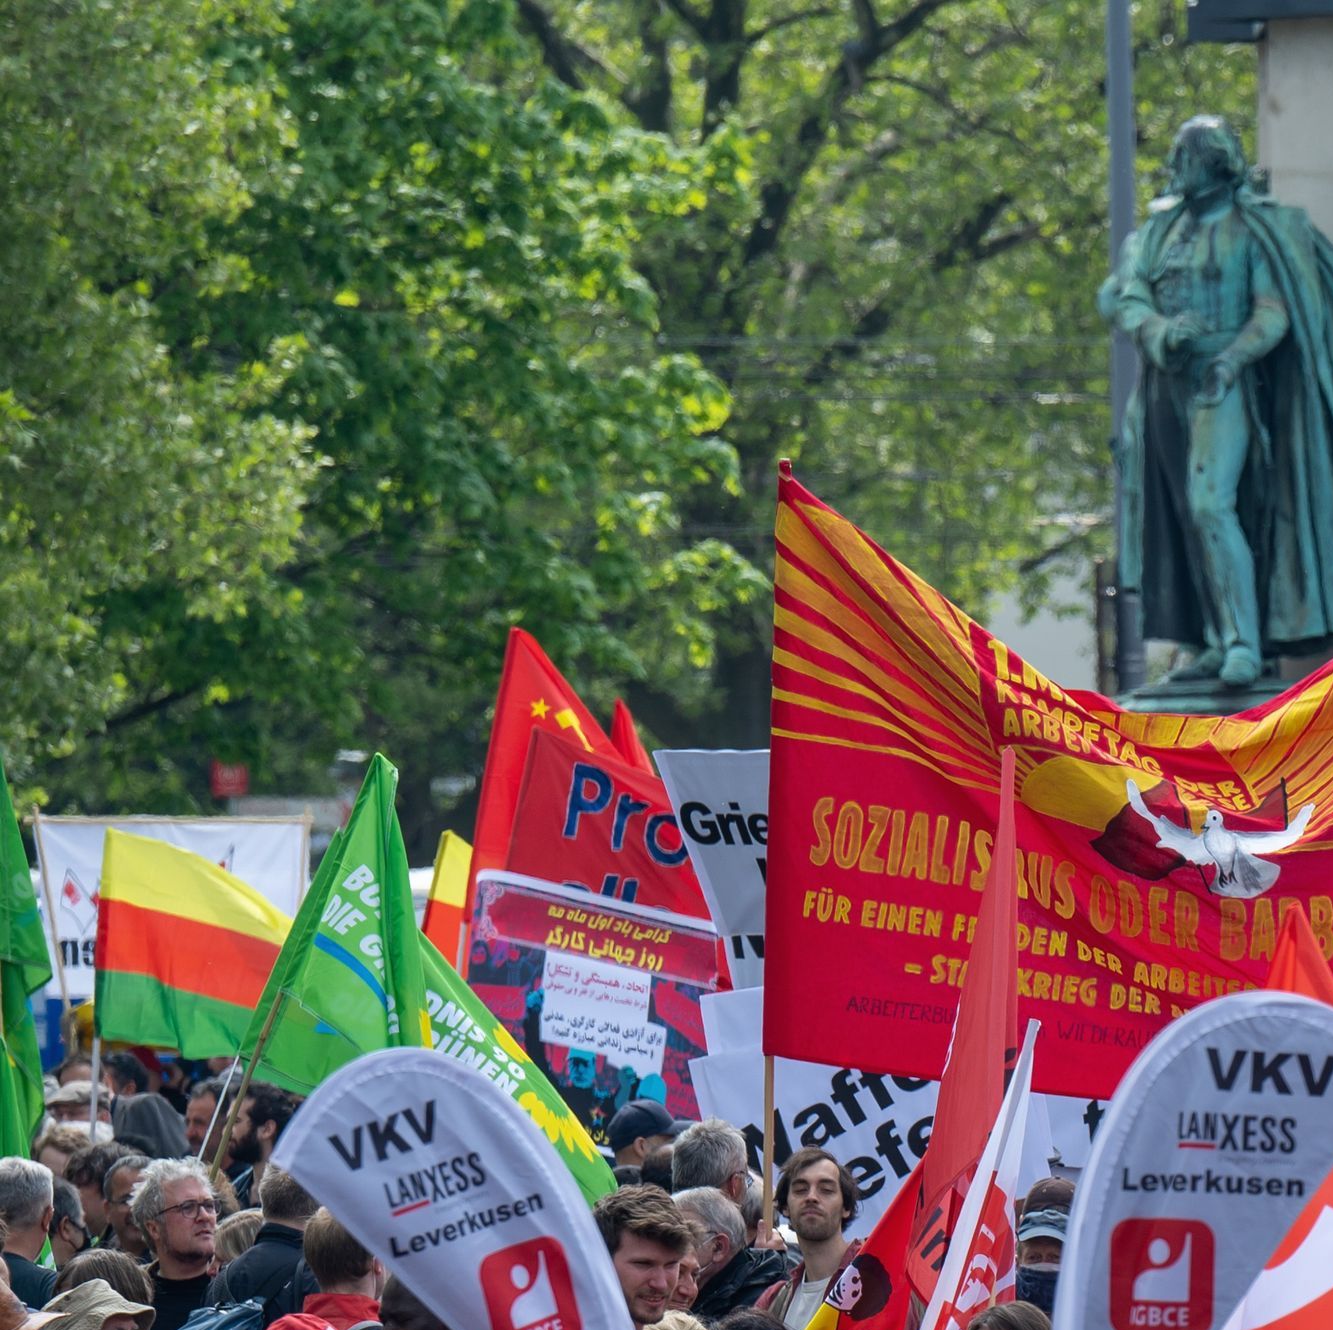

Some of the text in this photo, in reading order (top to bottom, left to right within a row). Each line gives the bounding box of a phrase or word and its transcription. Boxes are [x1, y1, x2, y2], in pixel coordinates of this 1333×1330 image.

[810, 797, 1076, 919] SOZIALISUS
[1090, 874, 1200, 951] ODER
[321, 894, 367, 935] DIE
[803, 887, 851, 924] FÜR
[861, 900, 943, 938] EINEN
[1077, 939, 1123, 974] DER
[1110, 984, 1161, 1015] DER
[492, 1045, 526, 1080] 90
[327, 1099, 438, 1171] VKV
[1177, 1110, 1296, 1154] LANXESS
[382, 1151, 488, 1211] LANXESS
[1121, 1167, 1306, 1199] Leverkusen
[389, 1192, 545, 1260] Leverkusen
